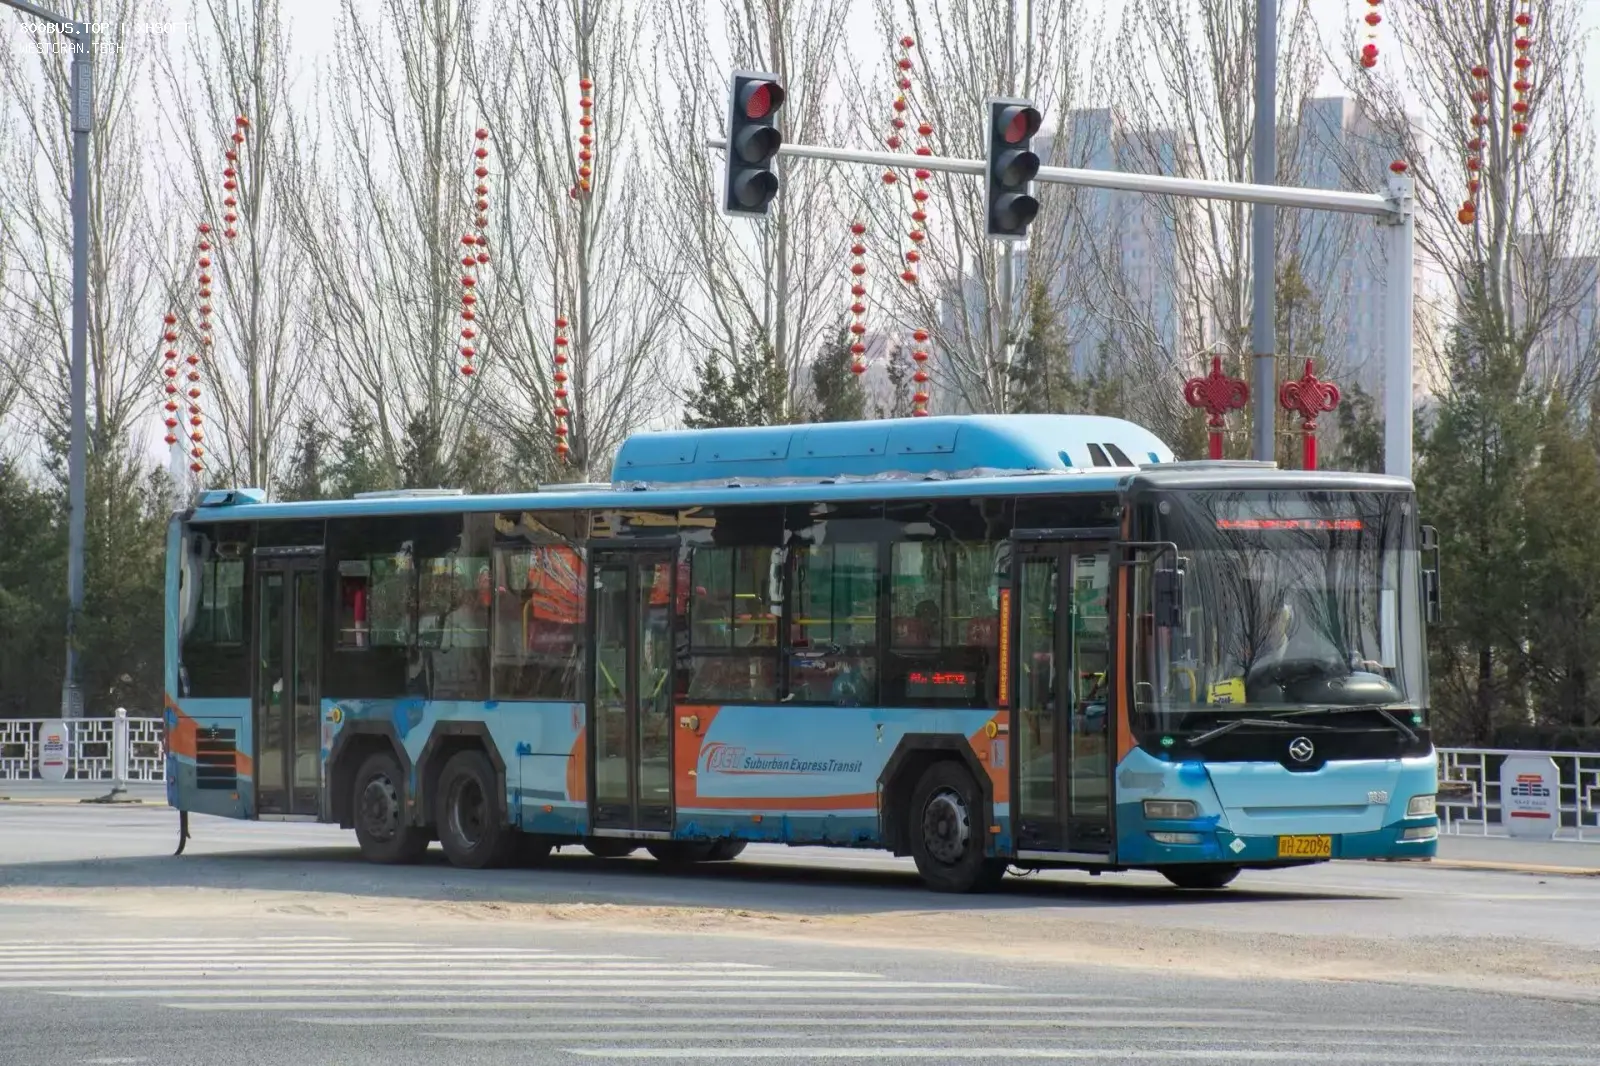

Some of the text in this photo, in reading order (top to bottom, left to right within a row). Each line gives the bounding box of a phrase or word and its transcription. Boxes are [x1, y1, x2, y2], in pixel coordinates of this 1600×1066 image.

[743, 757, 789, 770] Suburban
[790, 758, 827, 773] Express
[828, 759, 863, 773] Transit
